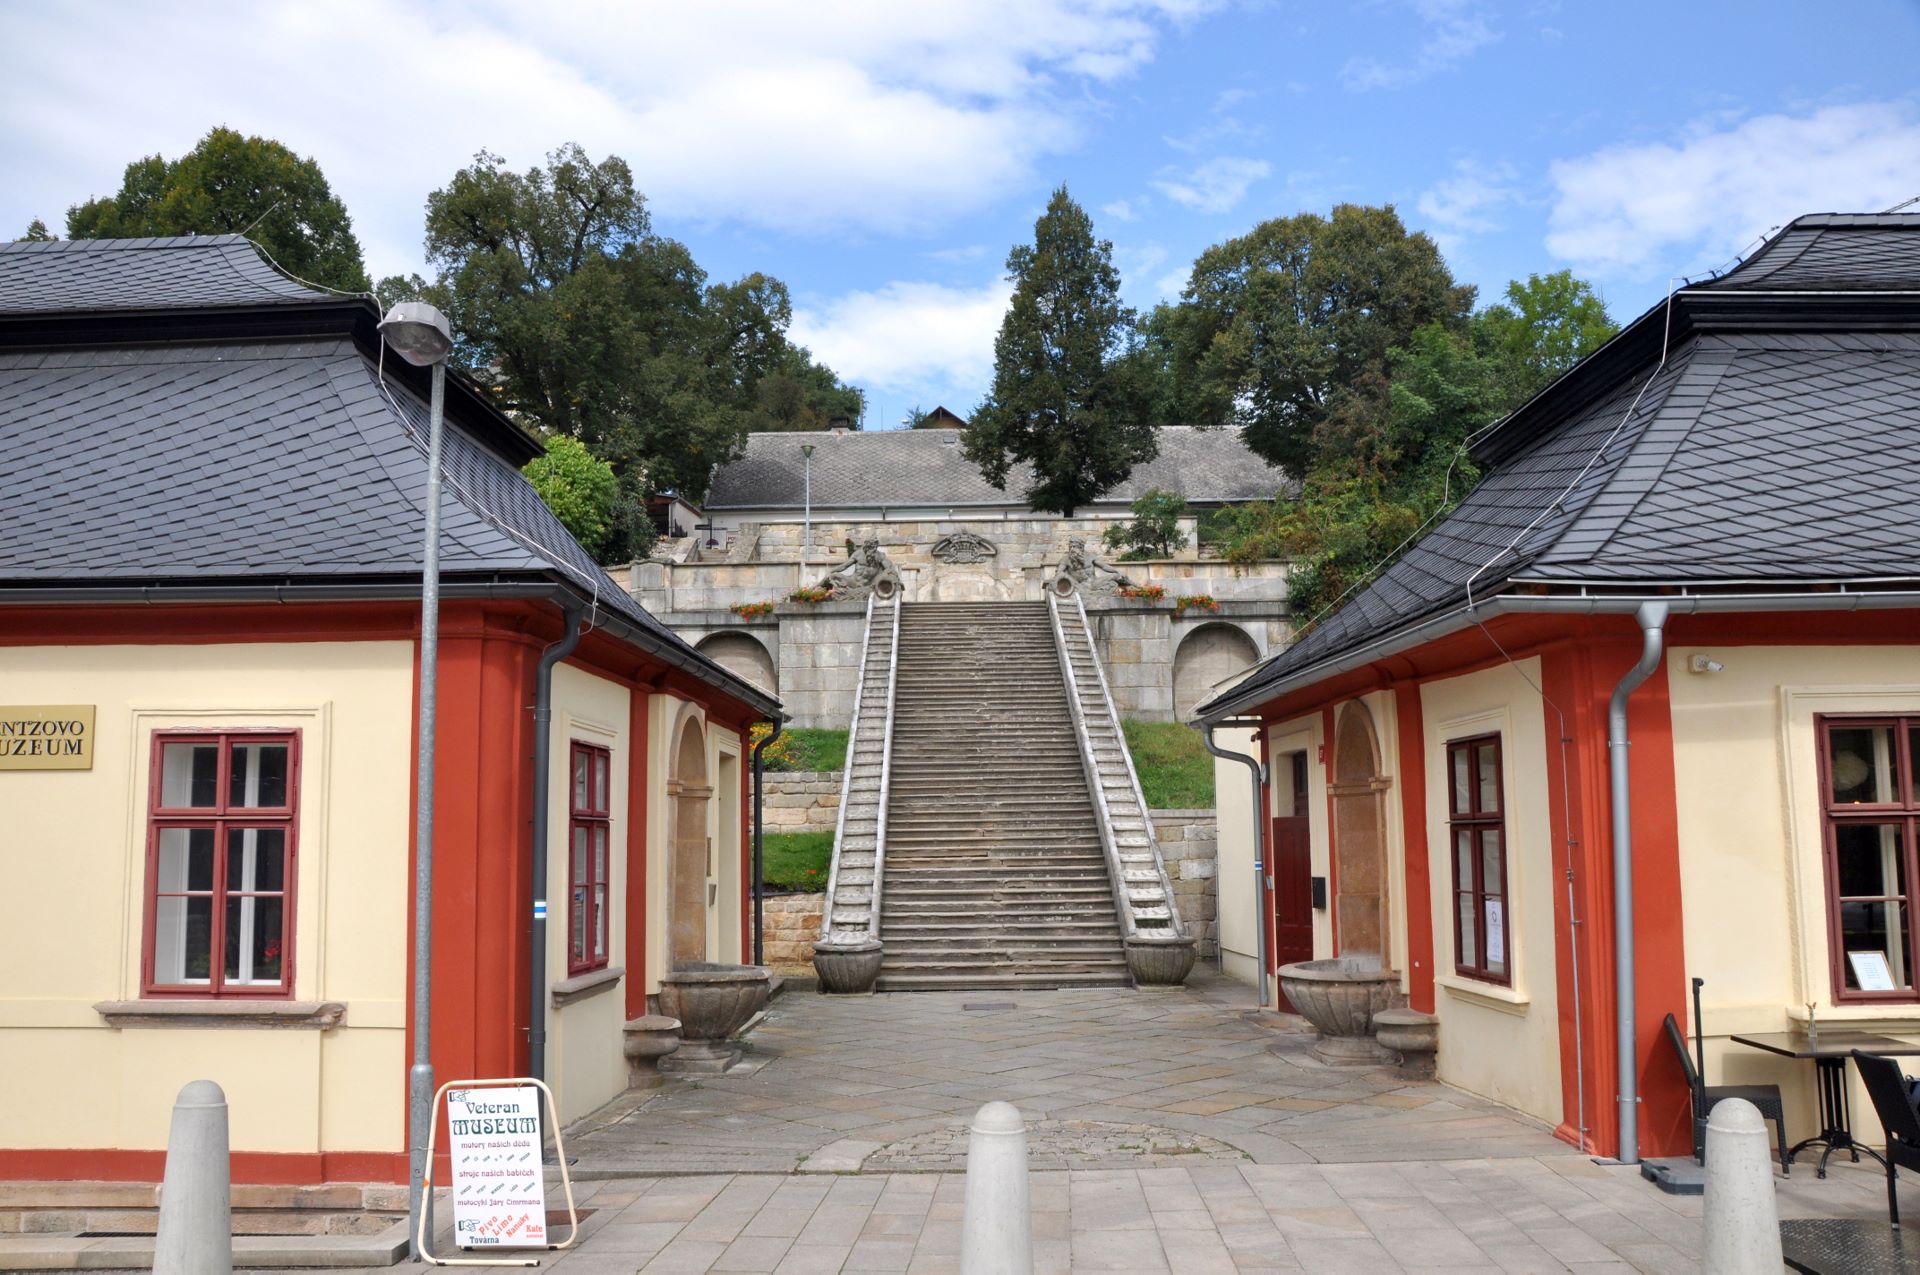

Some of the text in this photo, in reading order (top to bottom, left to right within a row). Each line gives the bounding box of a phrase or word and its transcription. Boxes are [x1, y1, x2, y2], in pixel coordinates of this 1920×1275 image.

[0, 720, 84, 736] NTZOVO
[465, 1102, 520, 1115] Veteran
[452, 1117, 537, 1136] MUSEUM
[461, 1142, 486, 1150] motory
[488, 1140, 511, 1149] našich
[459, 1171, 480, 1179] stroje
[479, 1215, 498, 1236] Pivo
[492, 1214, 513, 1237] Limo
[506, 1212, 530, 1238] Nanuky
